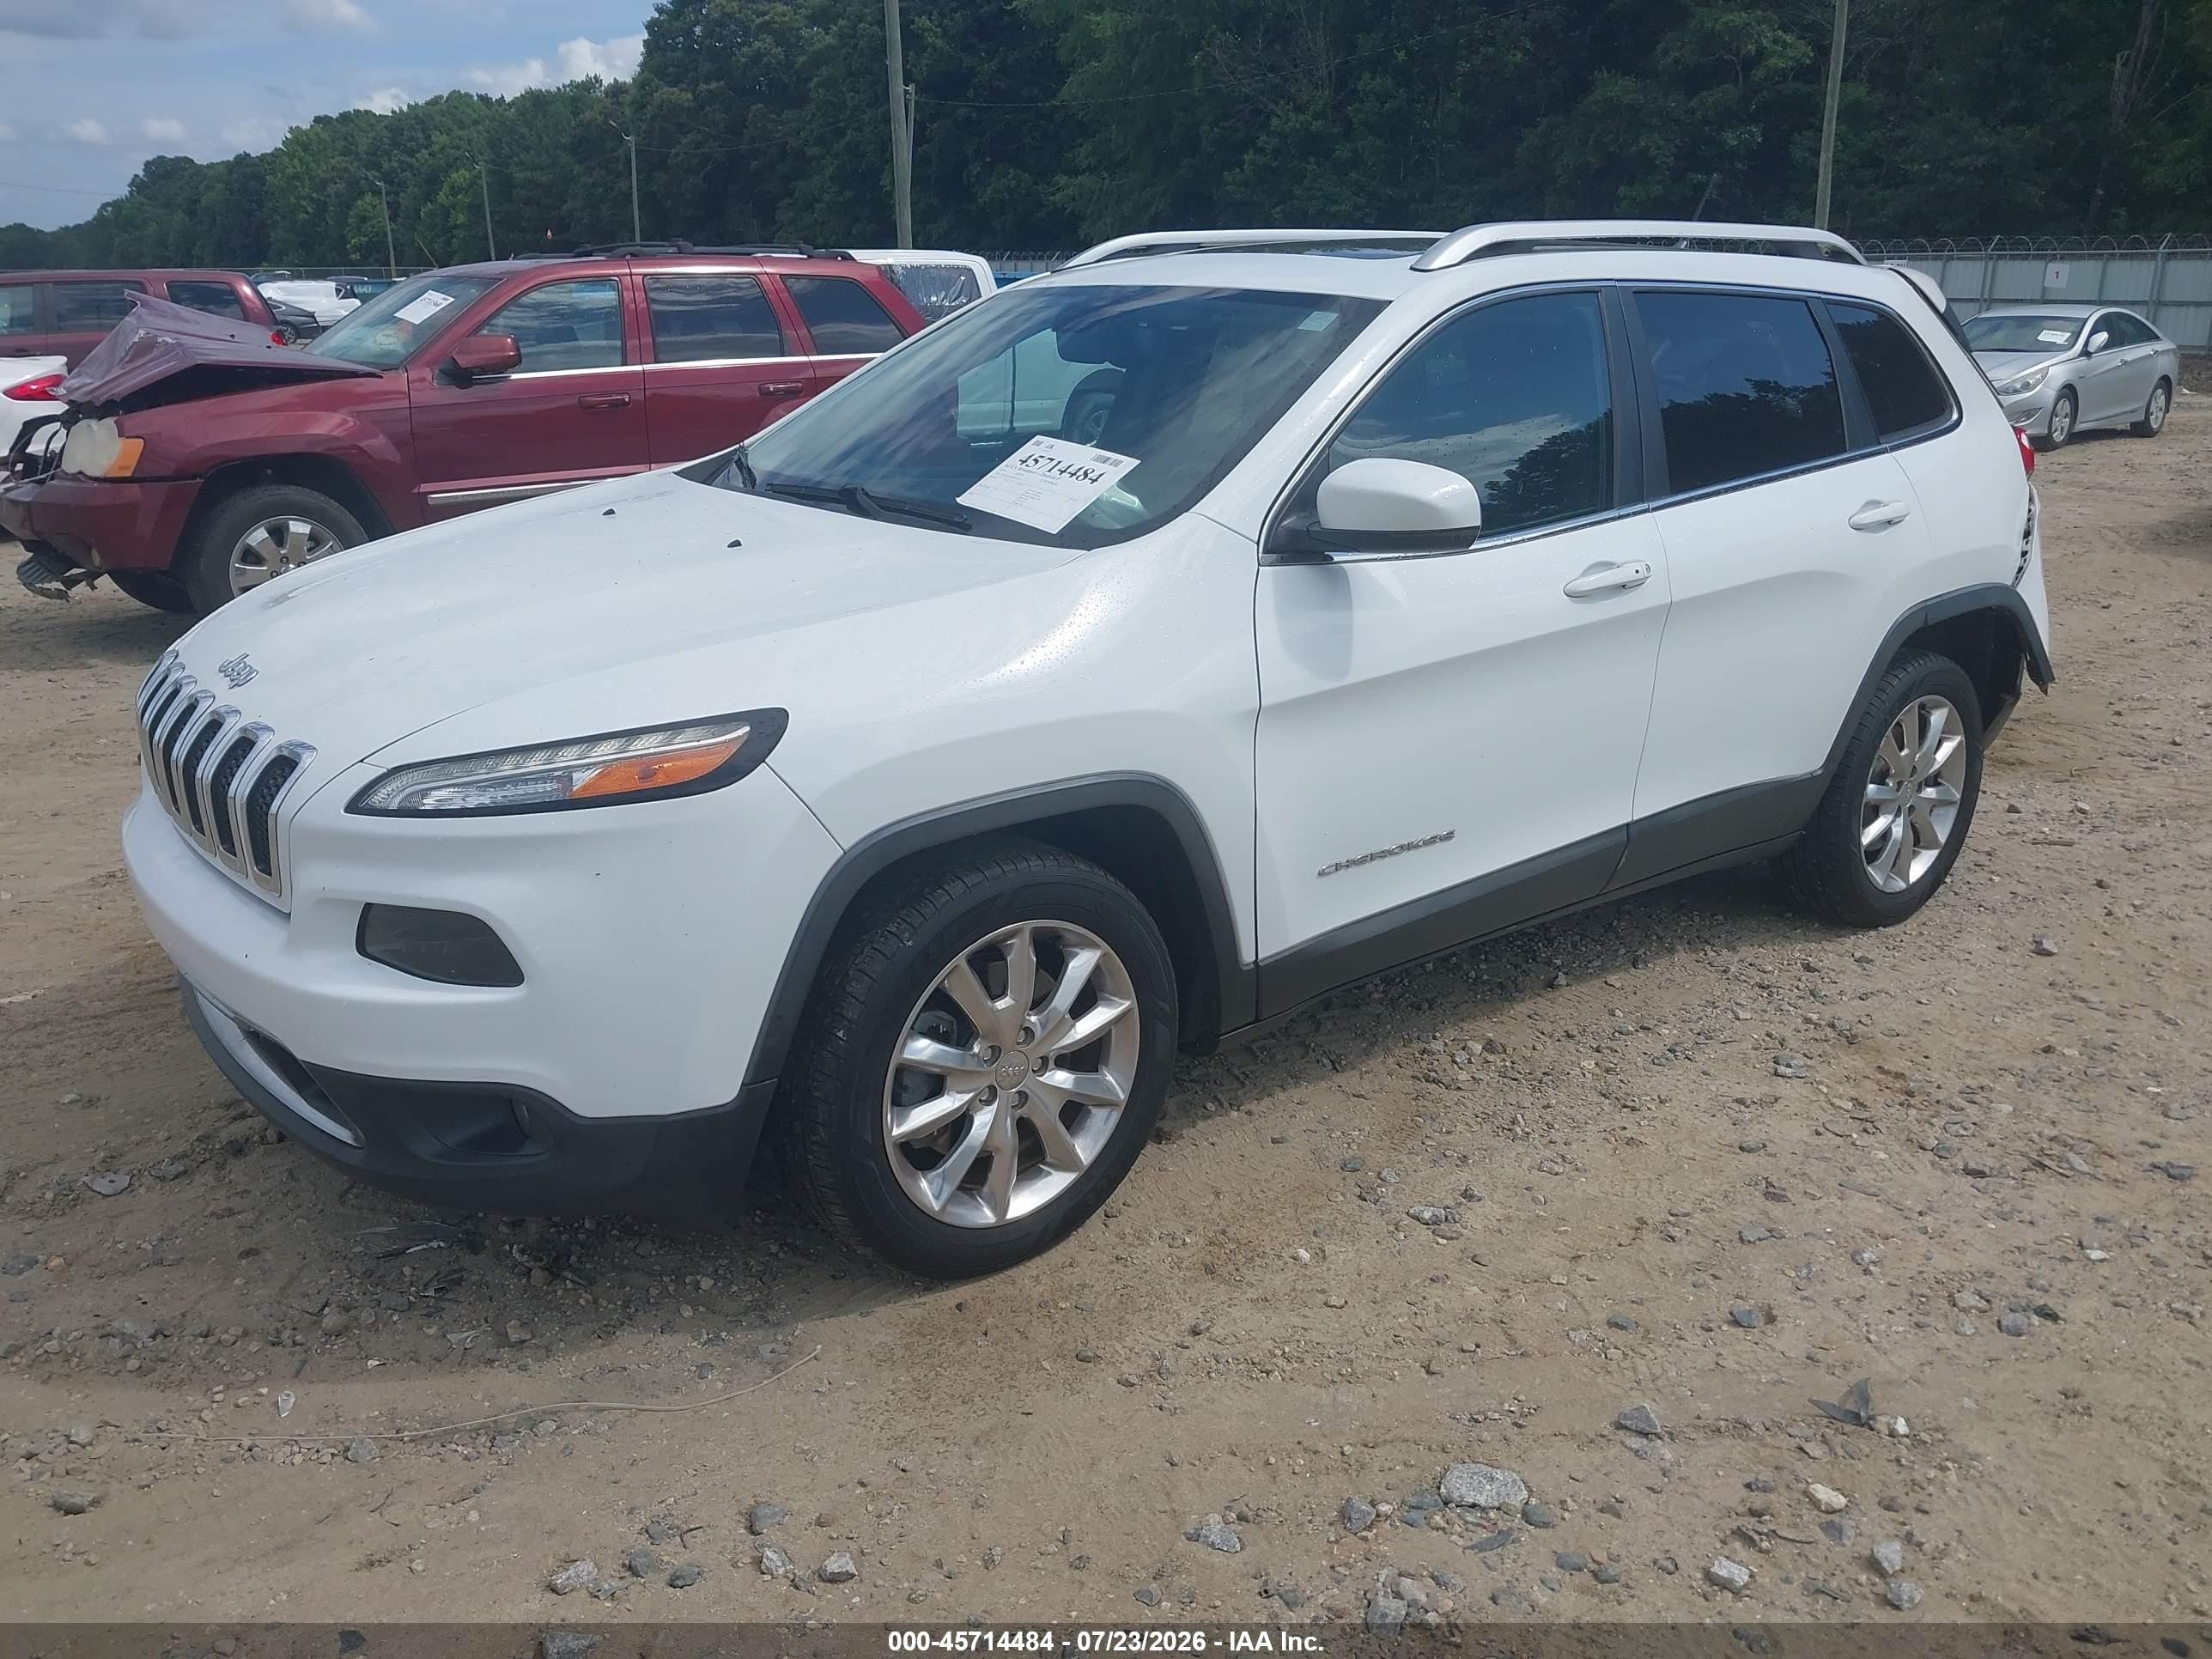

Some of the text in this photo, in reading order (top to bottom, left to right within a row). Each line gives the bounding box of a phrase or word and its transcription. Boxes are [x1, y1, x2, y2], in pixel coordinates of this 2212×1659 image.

[1018, 453, 1106, 485] 45714484
[218, 652, 259, 690] Jeep
[1317, 830, 1455, 877] CHEROKEE
